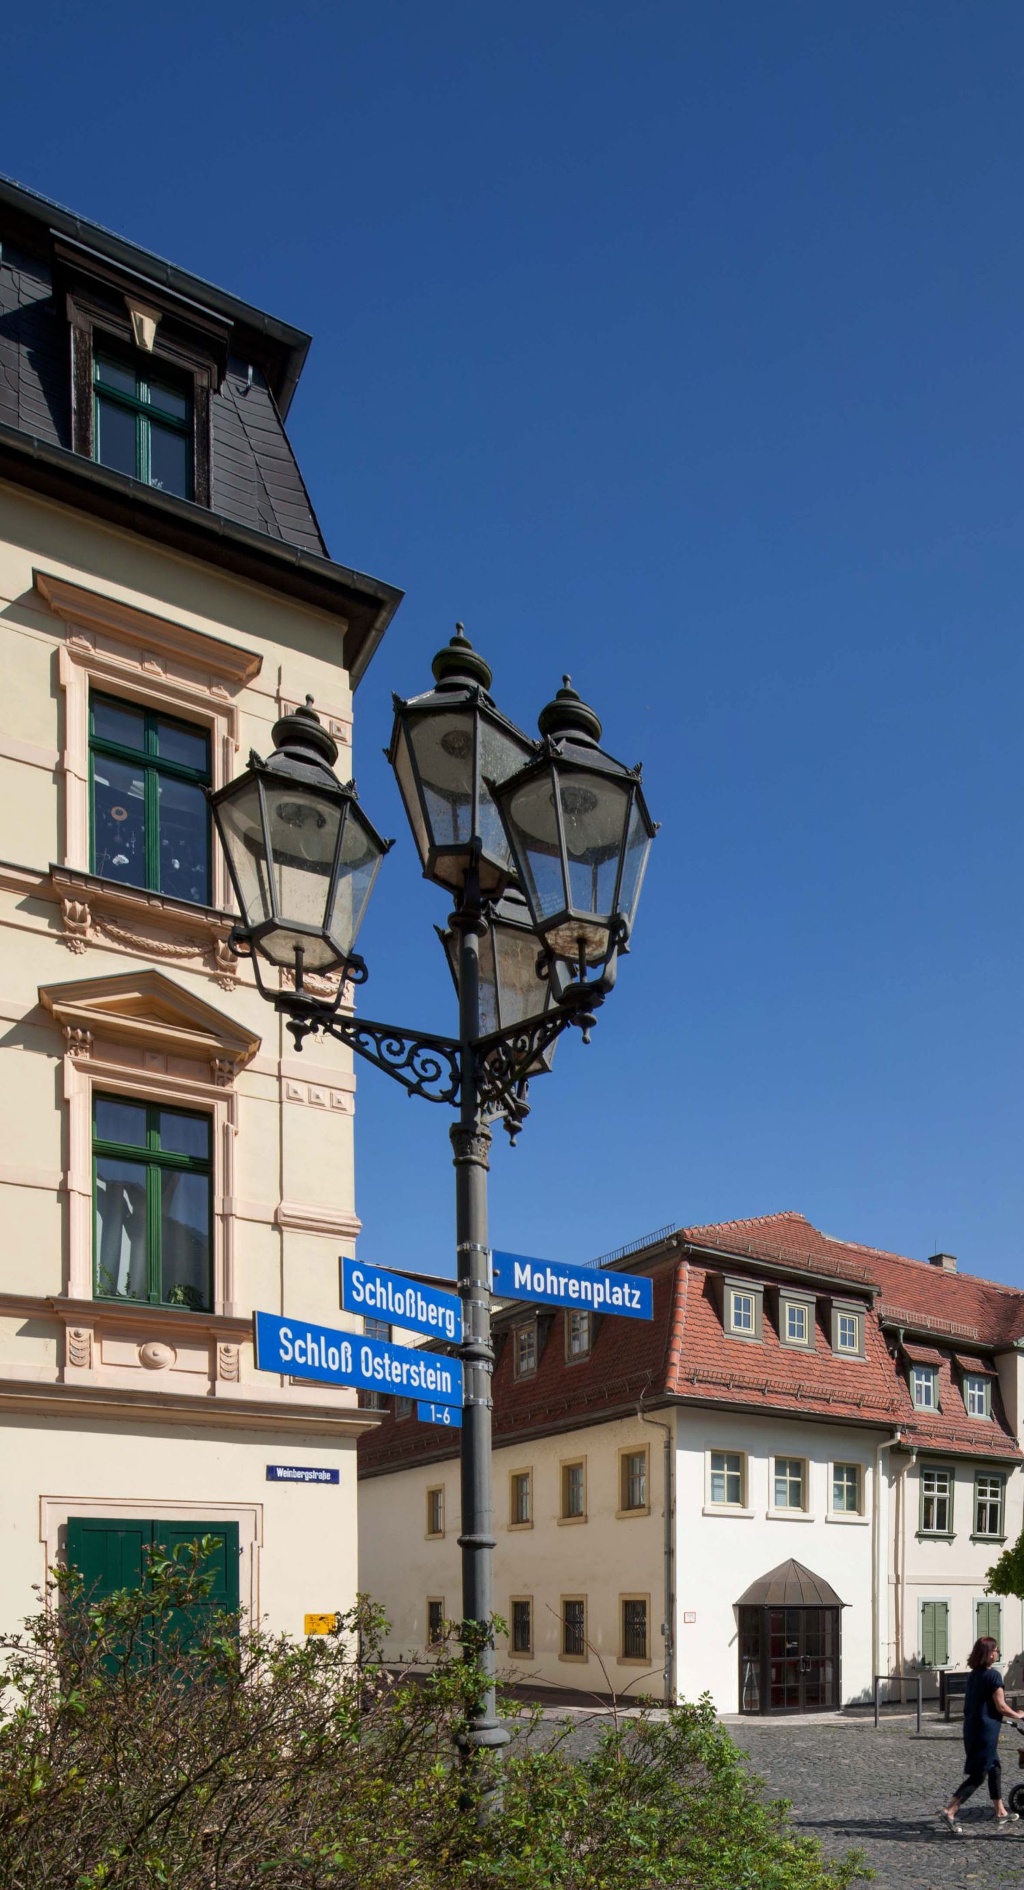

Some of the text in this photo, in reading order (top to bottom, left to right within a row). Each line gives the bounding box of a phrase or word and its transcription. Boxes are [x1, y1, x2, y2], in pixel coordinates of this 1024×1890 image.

[352, 1270, 455, 1338] Schloßberg
[515, 1262, 641, 1308] Mohrenplatz
[279, 1326, 452, 1393] Schloß Osterstein
[430, 1404, 451, 1423] 1-6
[276, 1467, 331, 1481] Weinbergstraße
